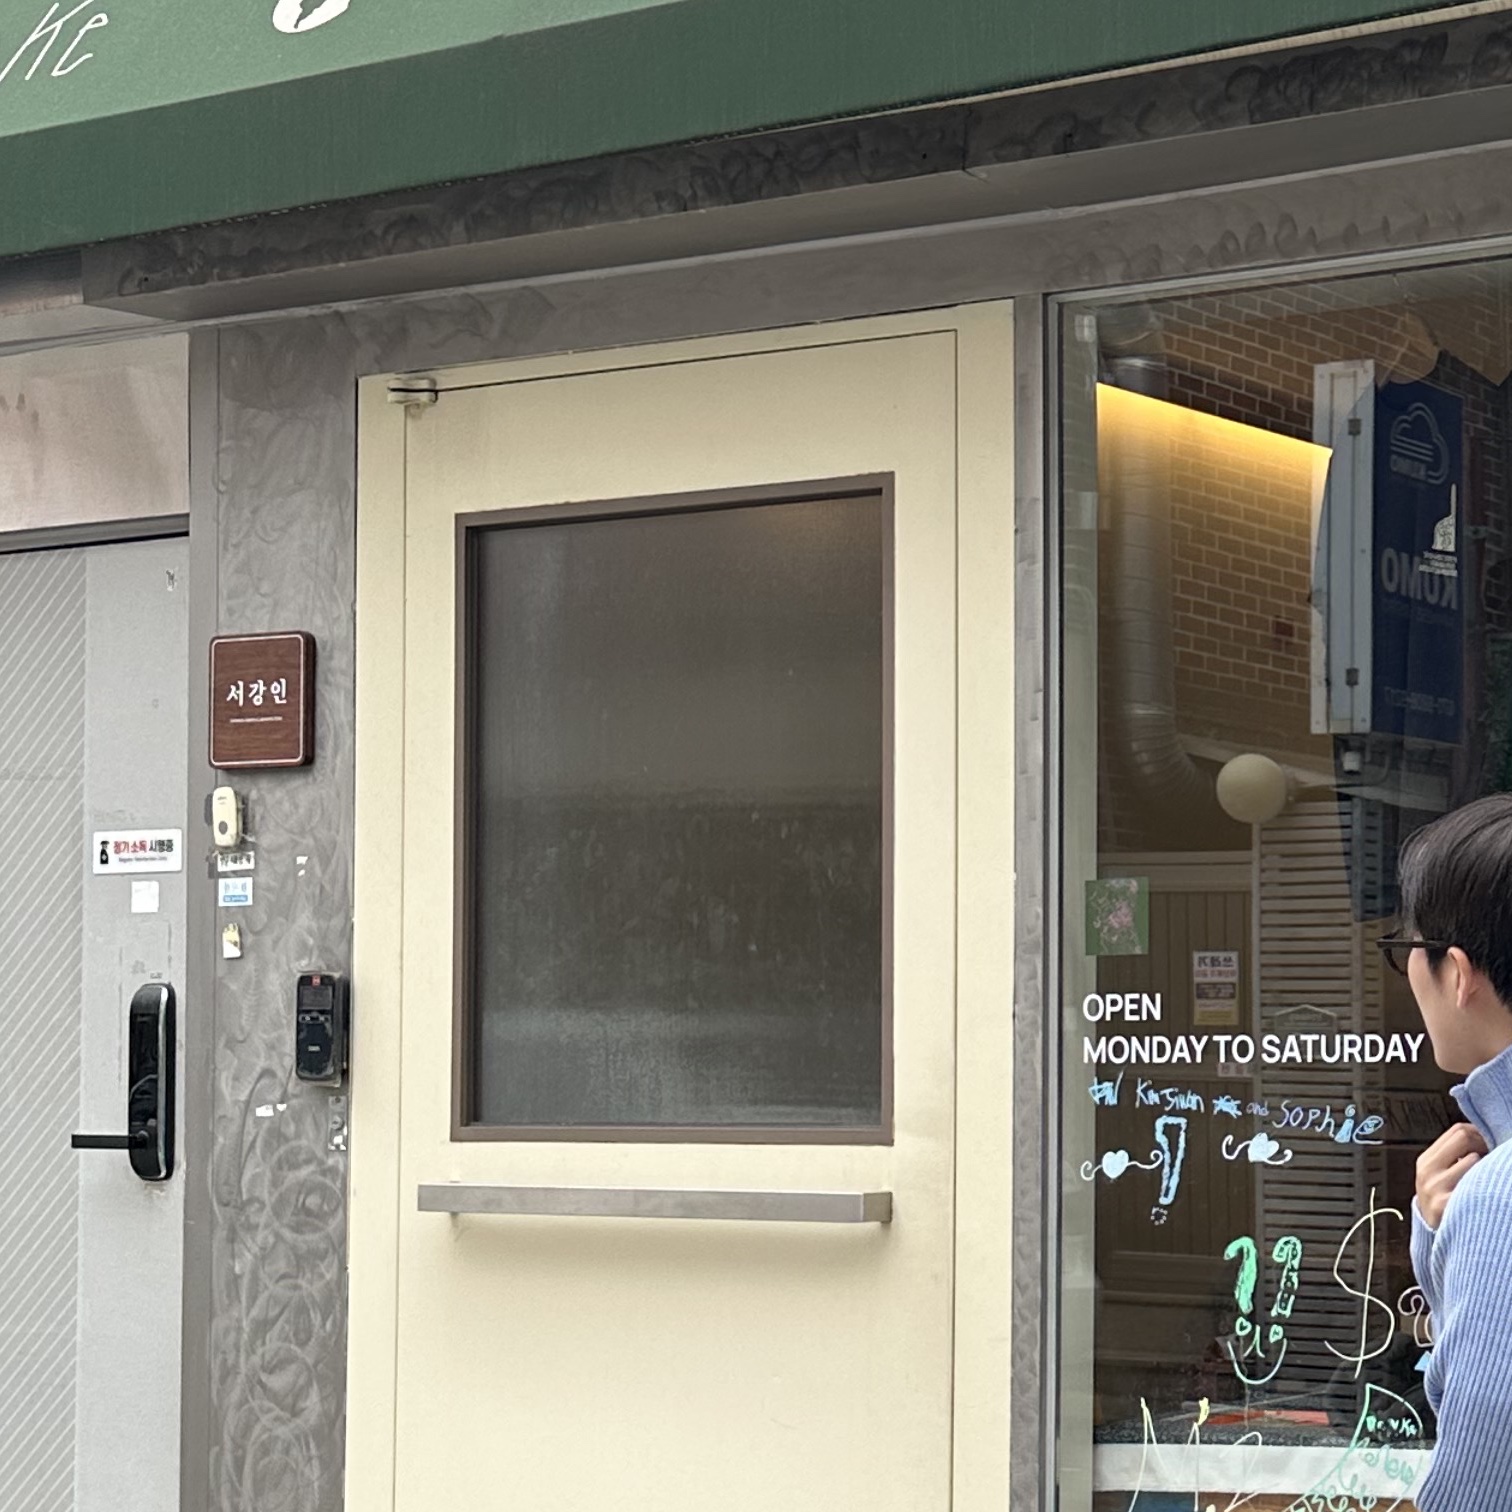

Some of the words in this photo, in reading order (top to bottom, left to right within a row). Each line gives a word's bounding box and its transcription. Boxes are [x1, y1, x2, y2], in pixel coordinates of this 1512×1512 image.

[225, 677, 288, 708] 서강인
[1082, 992, 1162, 1022] OPEN
[1082, 1034, 1208, 1065] MONDAY
[1213, 1034, 1255, 1064] TO
[1260, 1033, 1426, 1064] SATURDAY
